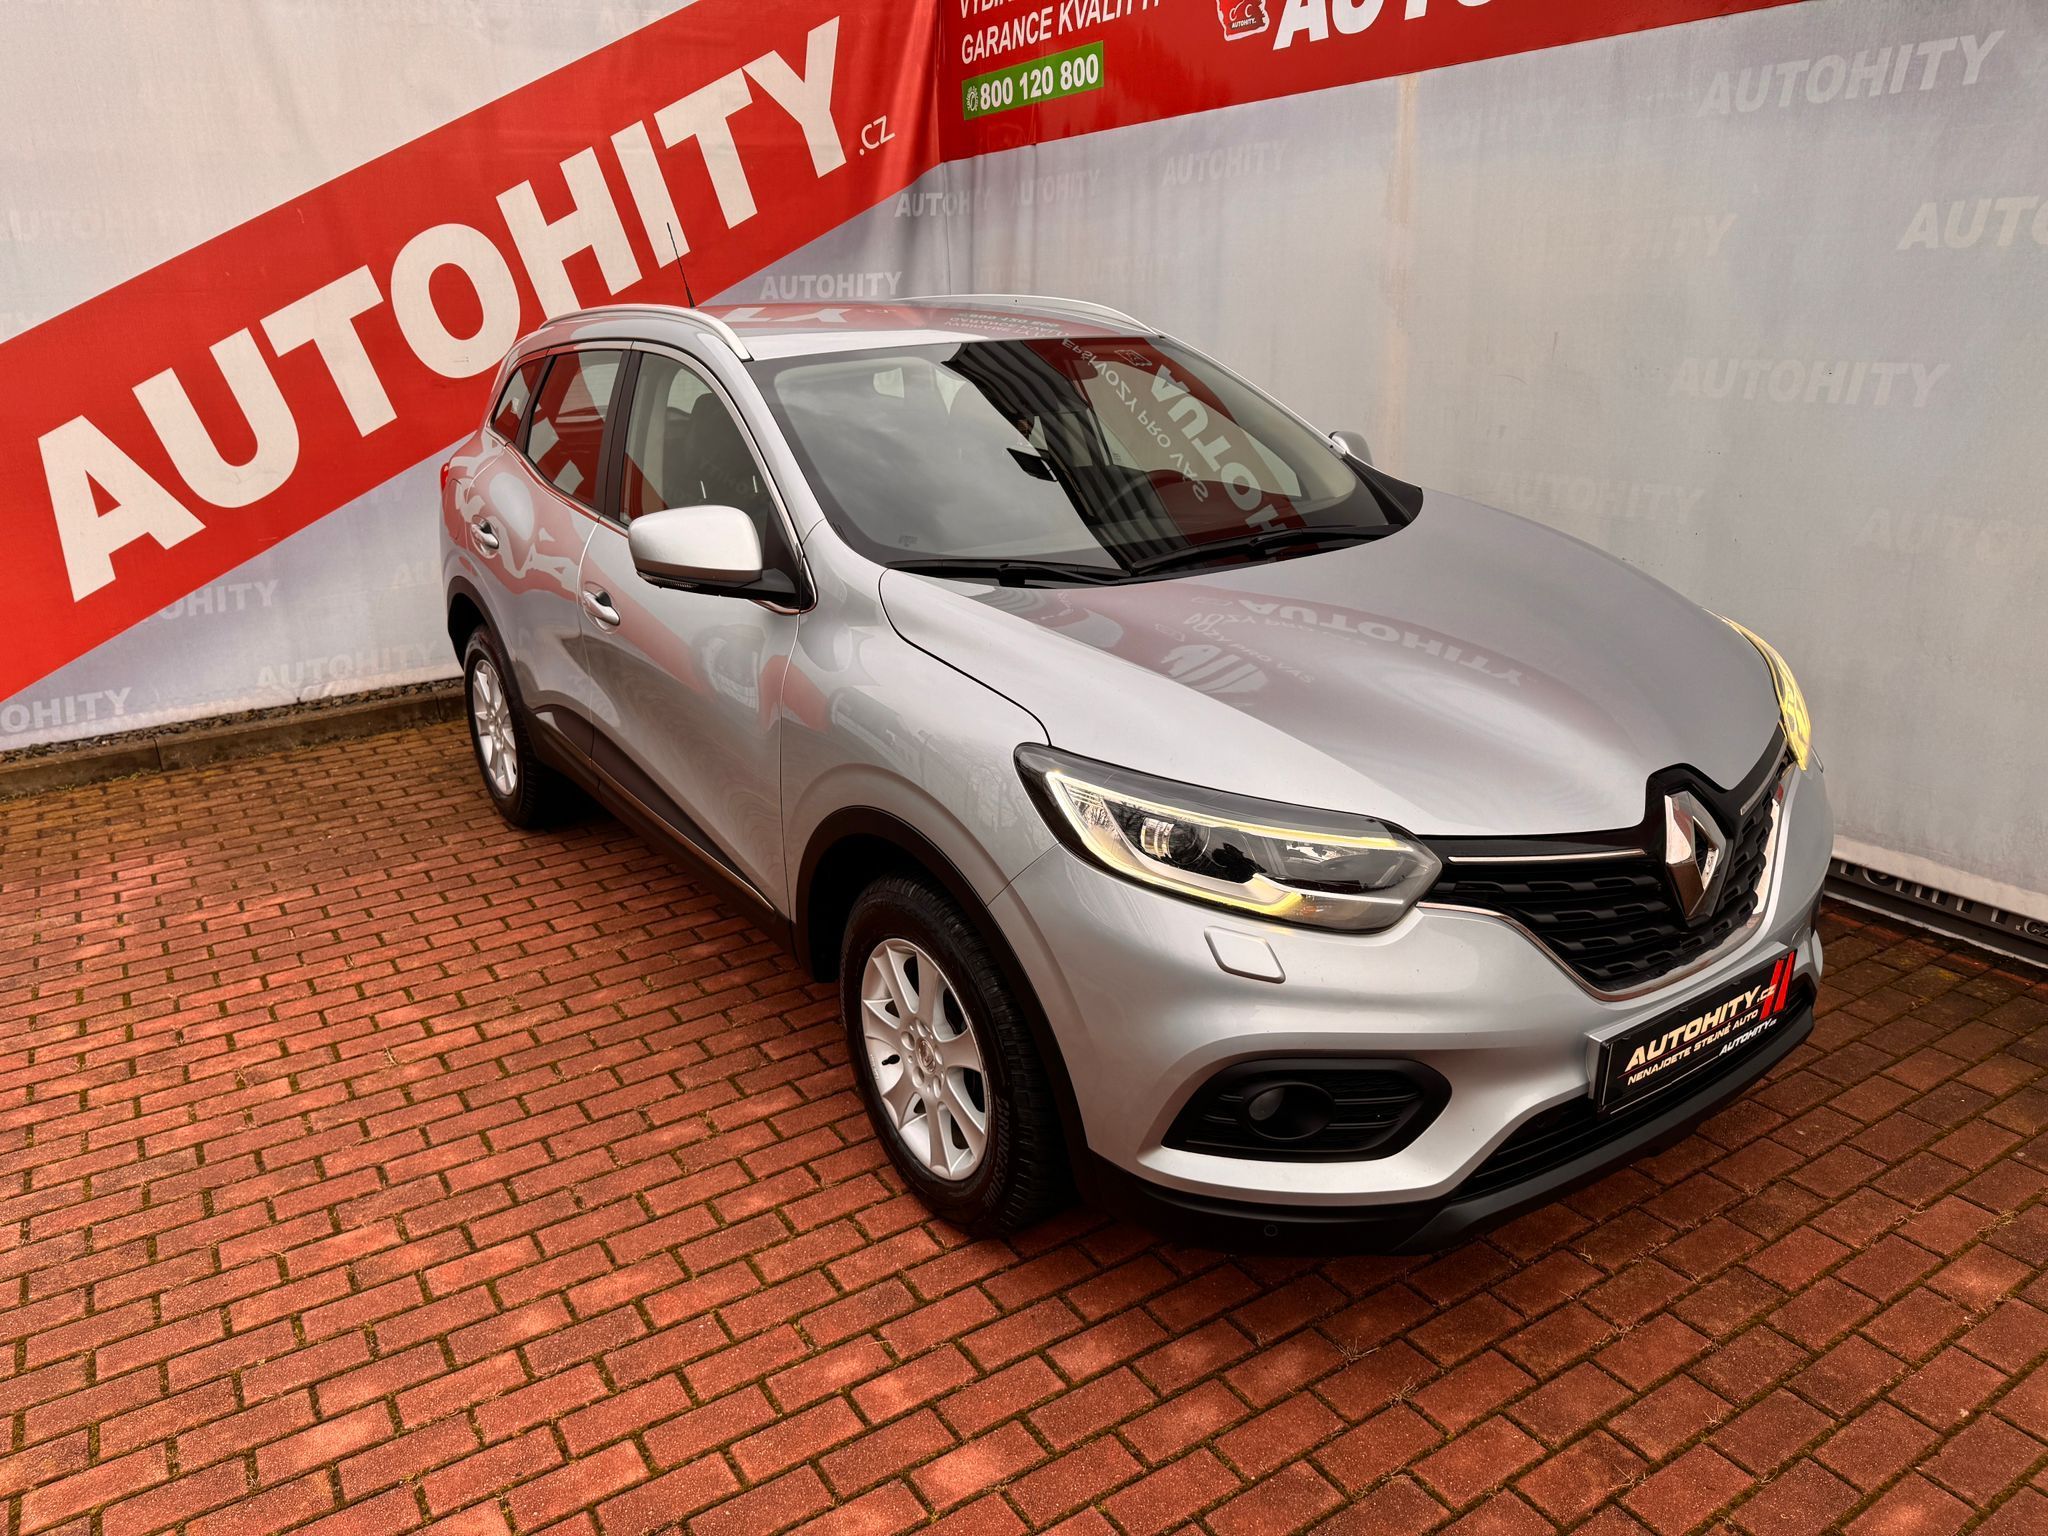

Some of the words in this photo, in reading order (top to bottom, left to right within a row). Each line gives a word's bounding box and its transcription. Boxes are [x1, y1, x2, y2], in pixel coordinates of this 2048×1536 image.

[961, 6, 1054, 64] GARANCE
[980, 77, 1013, 110] 800
[1019, 65, 1054, 100] 120
[1060, 53, 1099, 91] 800
[1698, 30, 2006, 117] AUTOHITY
[759, 271, 902, 301] AUTOHITY
[1627, 1048, 1691, 1086] NENAJDETE
[1693, 1022, 1731, 1052] STEJNÉ
[1731, 1009, 1759, 1031] AUTO
